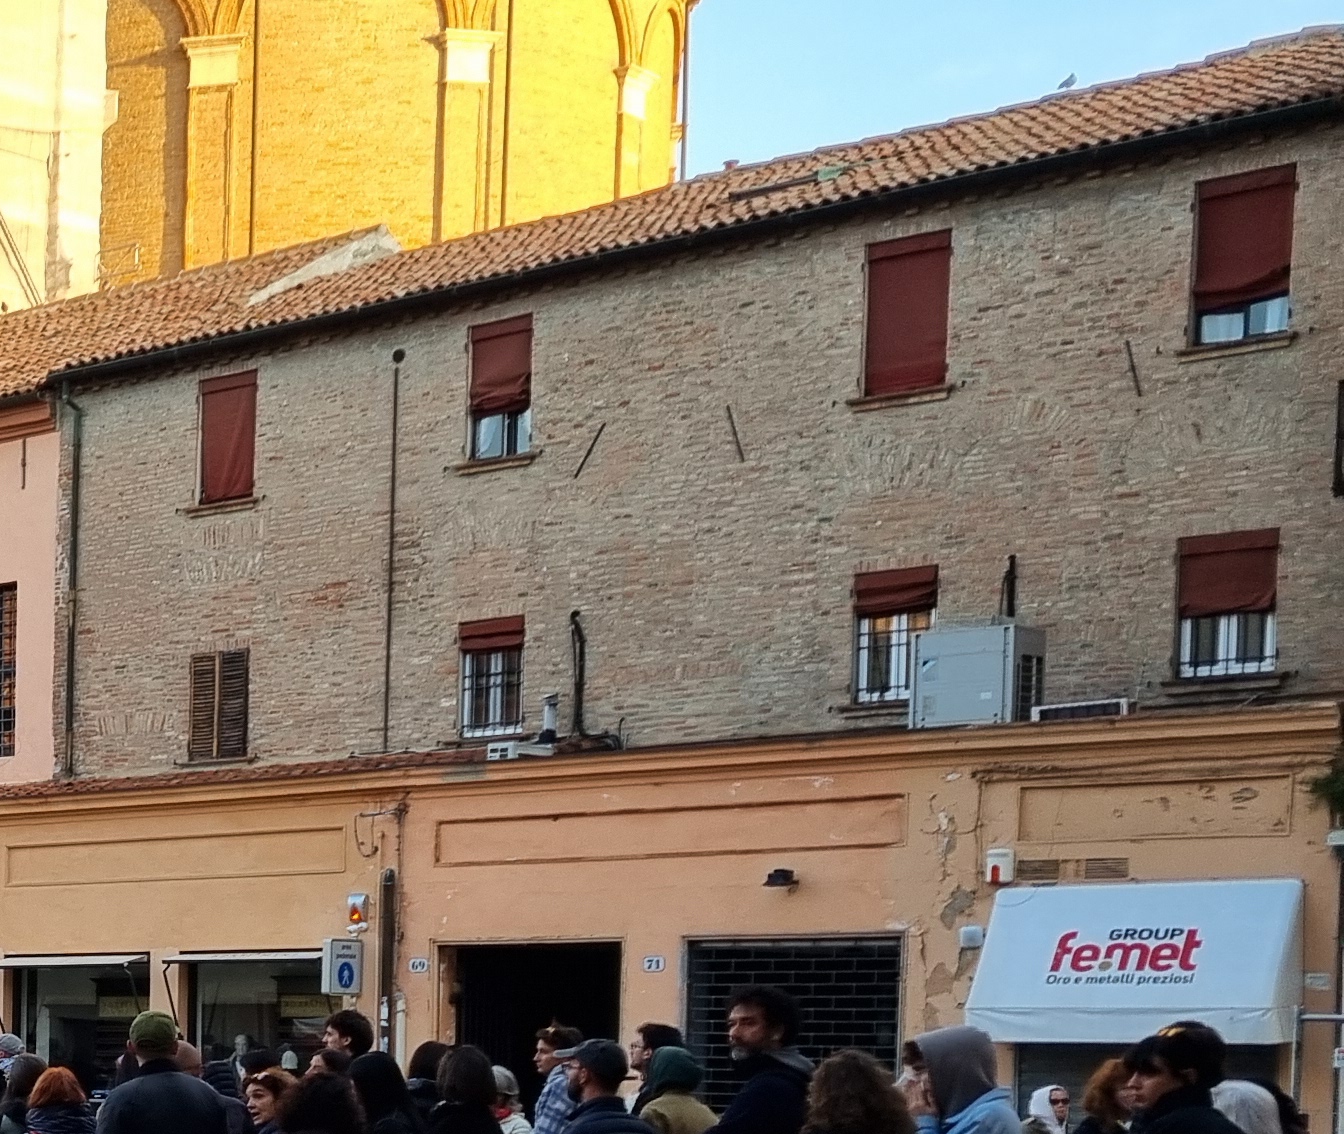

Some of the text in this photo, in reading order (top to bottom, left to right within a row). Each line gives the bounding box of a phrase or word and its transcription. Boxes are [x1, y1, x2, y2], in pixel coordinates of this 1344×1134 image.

[1109, 927, 1185, 941] GROUP
[411, 960, 426, 971] 69
[646, 959, 660, 970] 71
[1045, 972, 1196, 986] Oro e metalli preziosi
